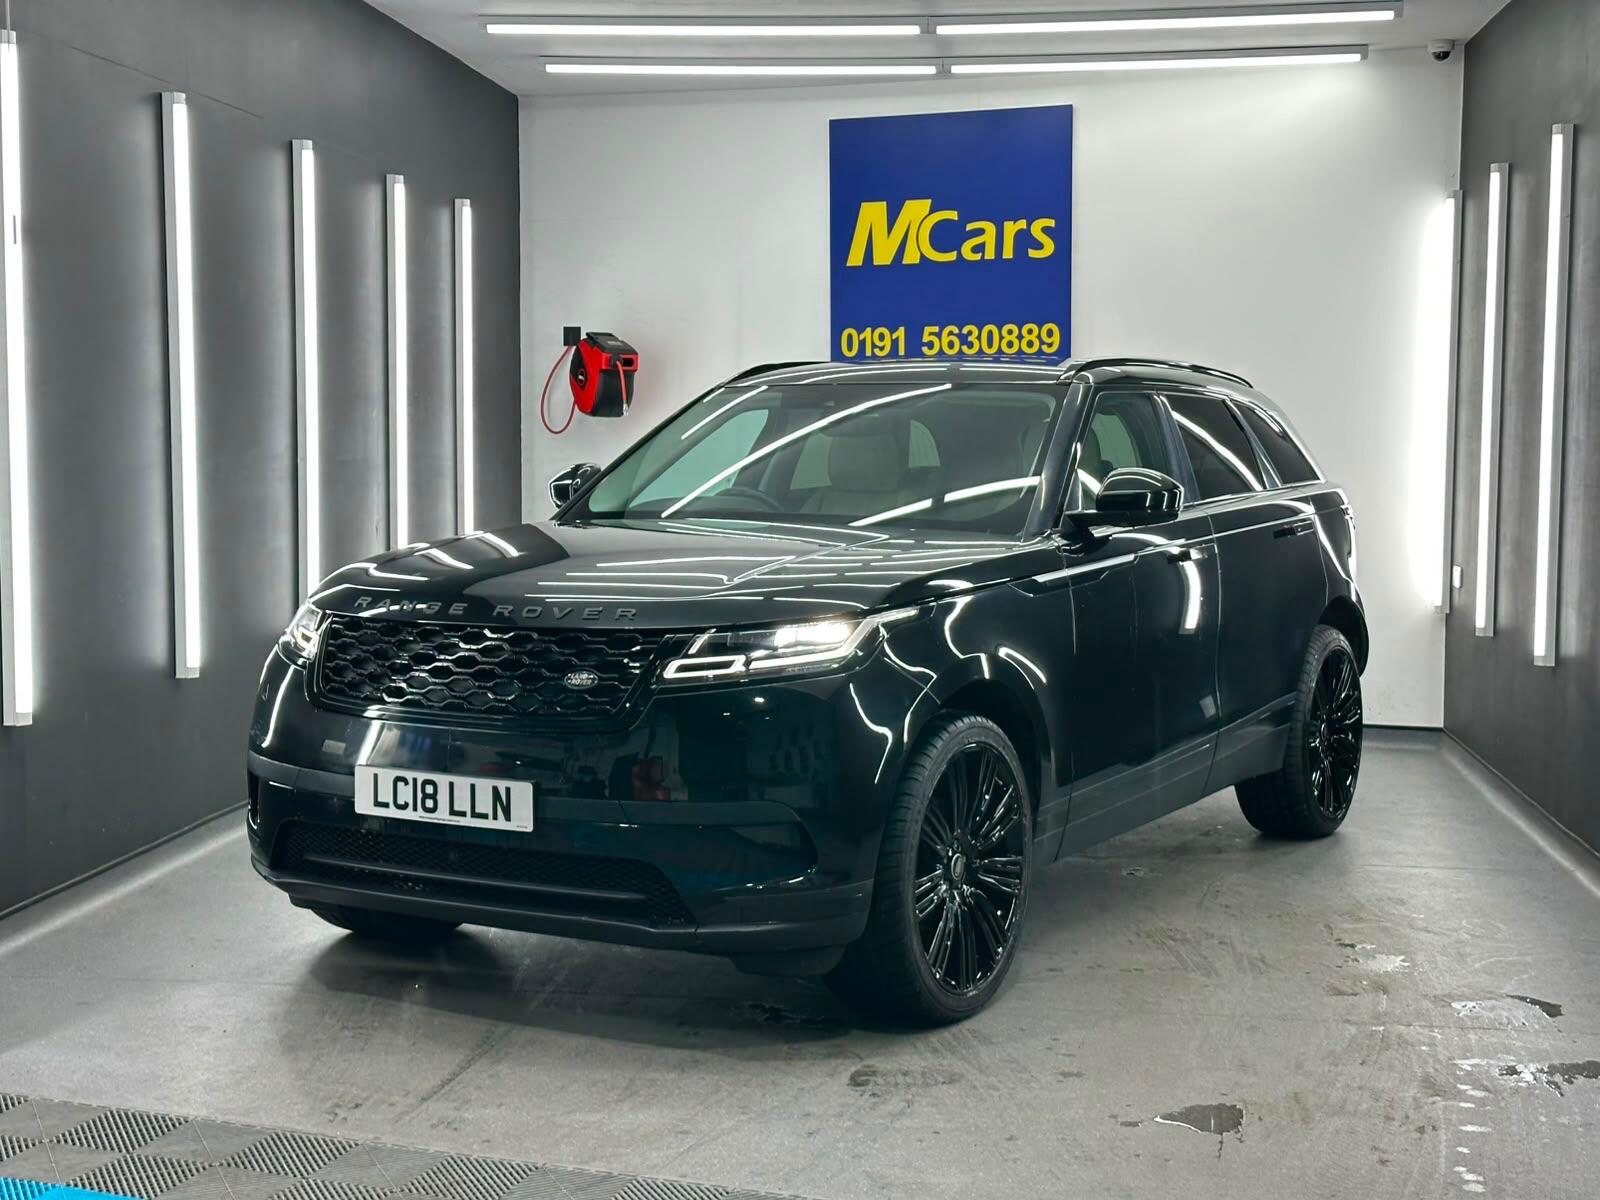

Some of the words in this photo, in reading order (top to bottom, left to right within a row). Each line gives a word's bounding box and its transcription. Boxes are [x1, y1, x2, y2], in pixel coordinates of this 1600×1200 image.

[840, 326, 905, 357] 0191
[921, 322, 1060, 355] 5630889
[354, 596, 468, 615] RANGE
[492, 605, 637, 620] ROVER
[373, 773, 438, 814] LC18
[448, 781, 511, 822] LLN
